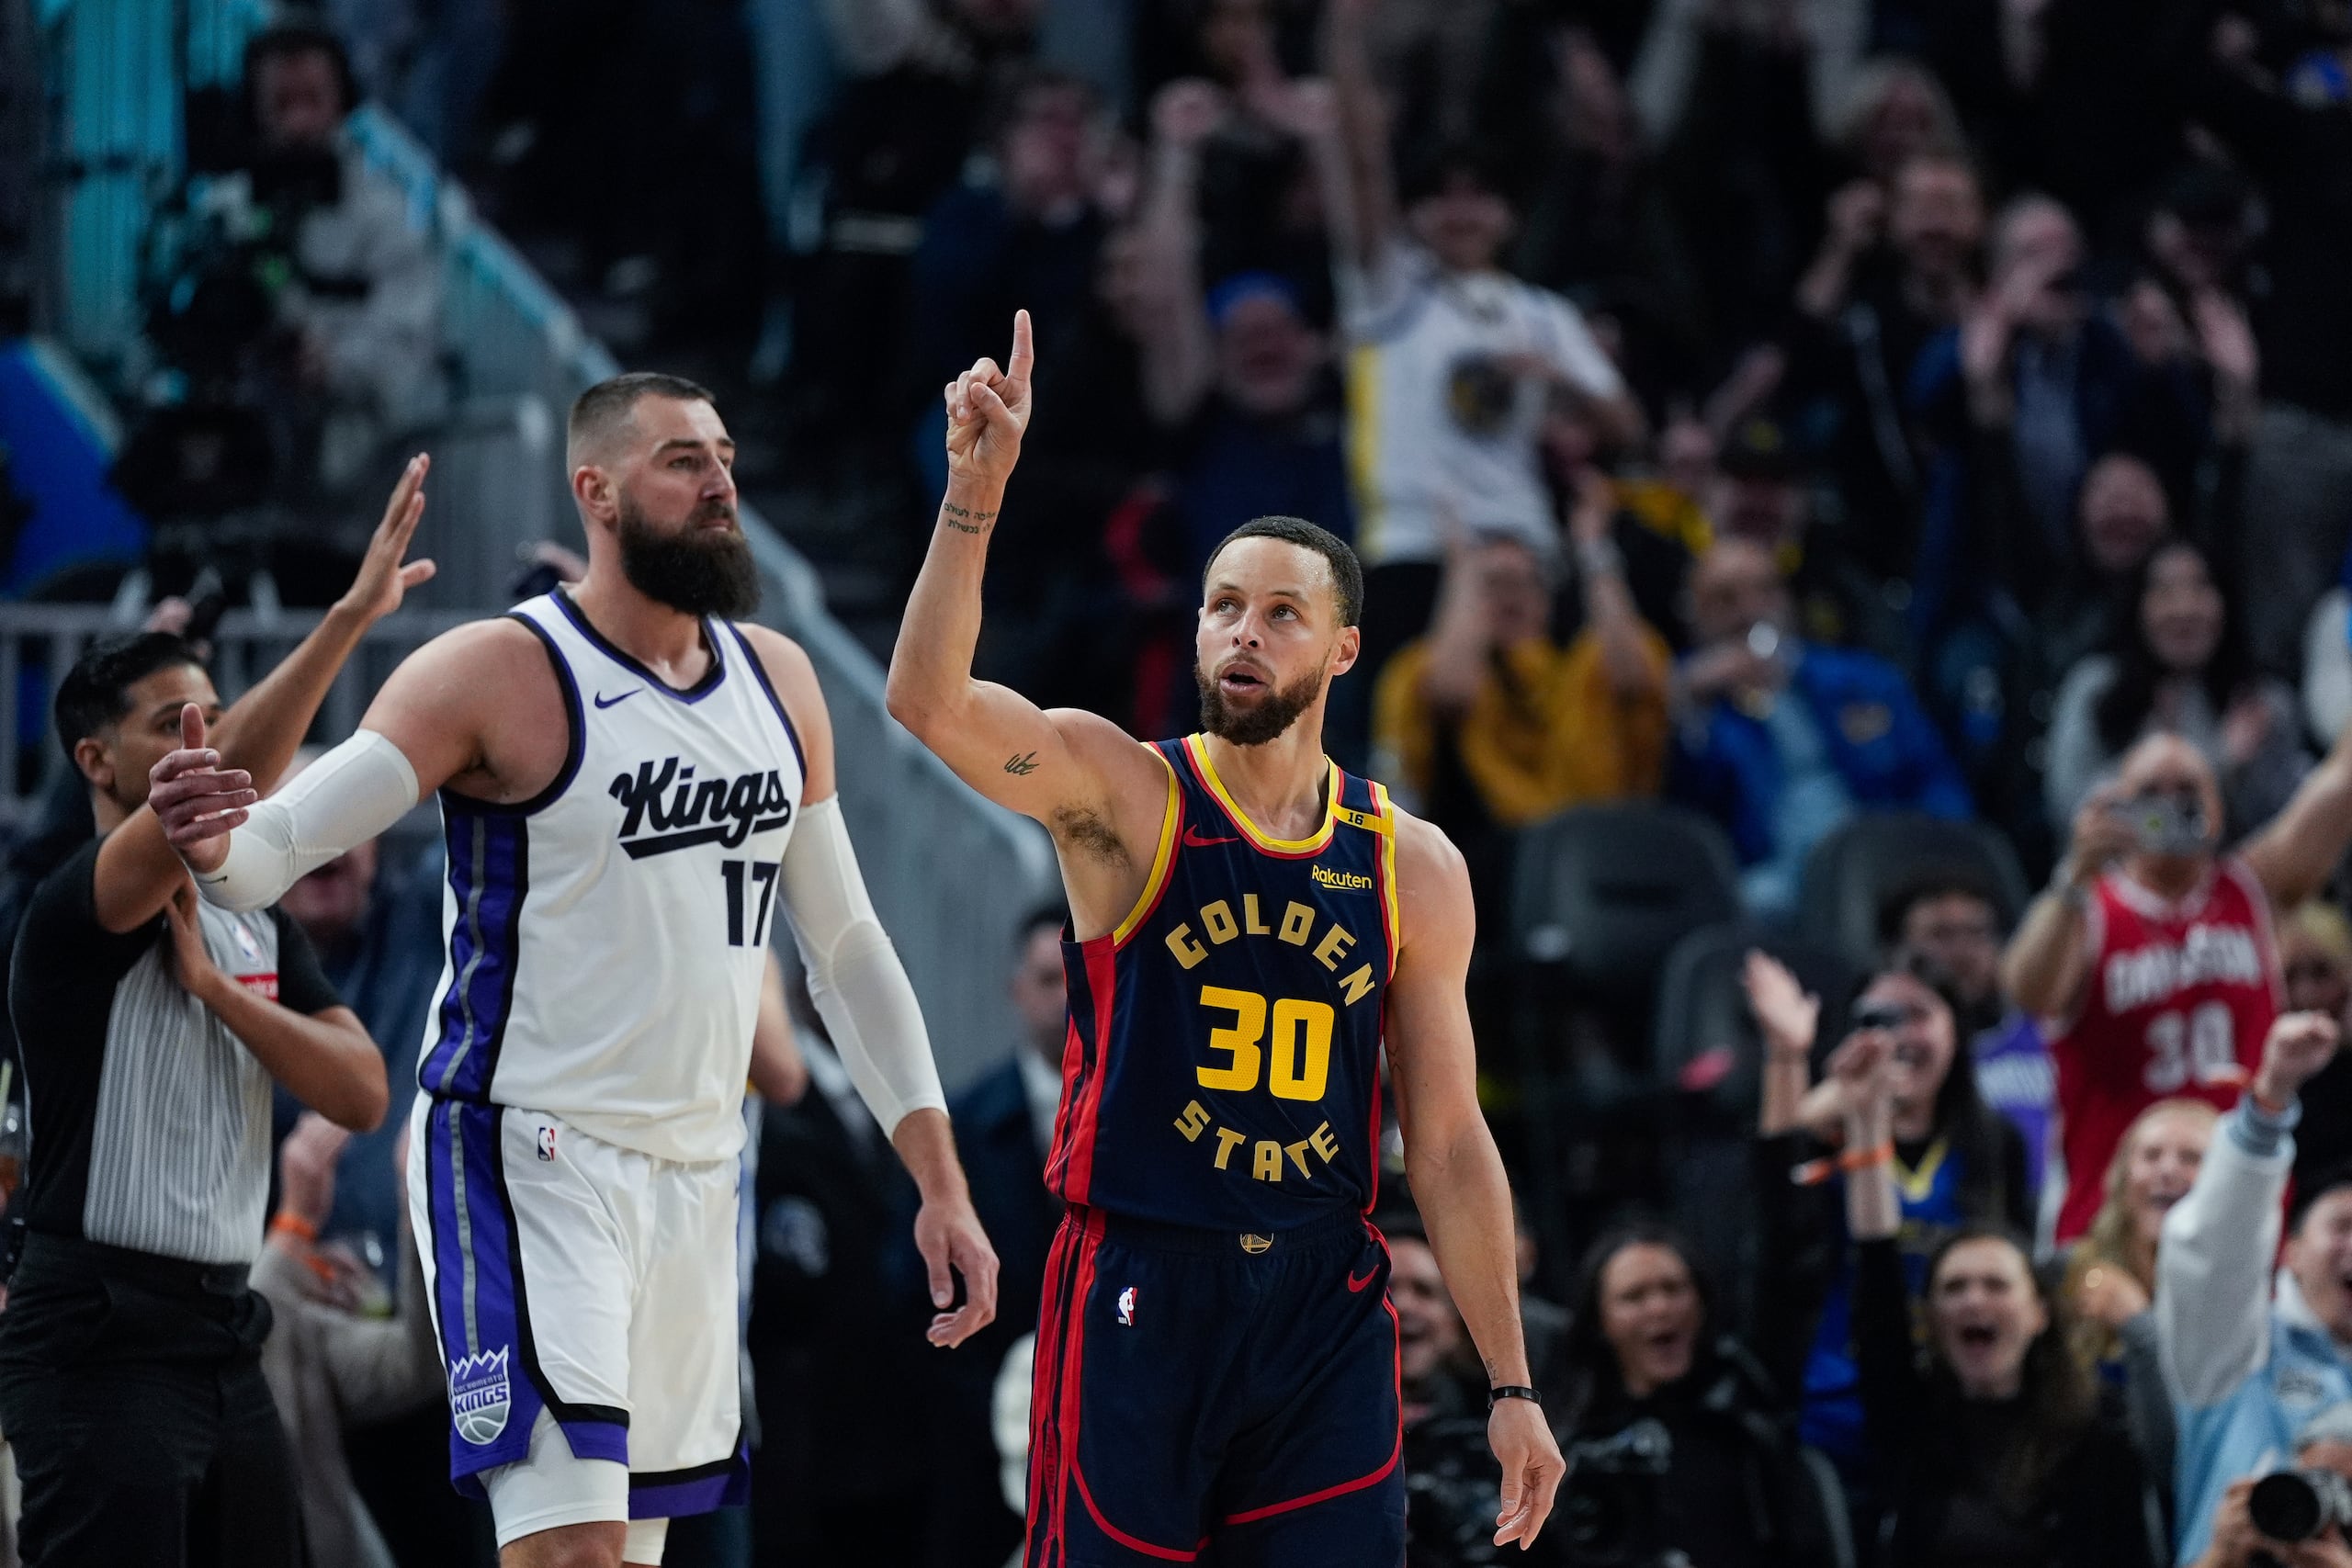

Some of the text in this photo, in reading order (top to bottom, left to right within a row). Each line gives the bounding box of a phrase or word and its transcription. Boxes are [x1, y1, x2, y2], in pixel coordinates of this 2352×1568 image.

[608, 757, 790, 860] Kings
[1348, 812, 1364, 825] 16
[721, 860, 780, 946] 17
[1311, 863, 1373, 889] Rakuten
[1165, 894, 1375, 1006] GOLDEN
[1196, 985, 1335, 1101] 30
[2145, 1001, 2233, 1091] 30
[1173, 1100, 1340, 1182] STATE
[455, 1384, 507, 1414] KINGS
